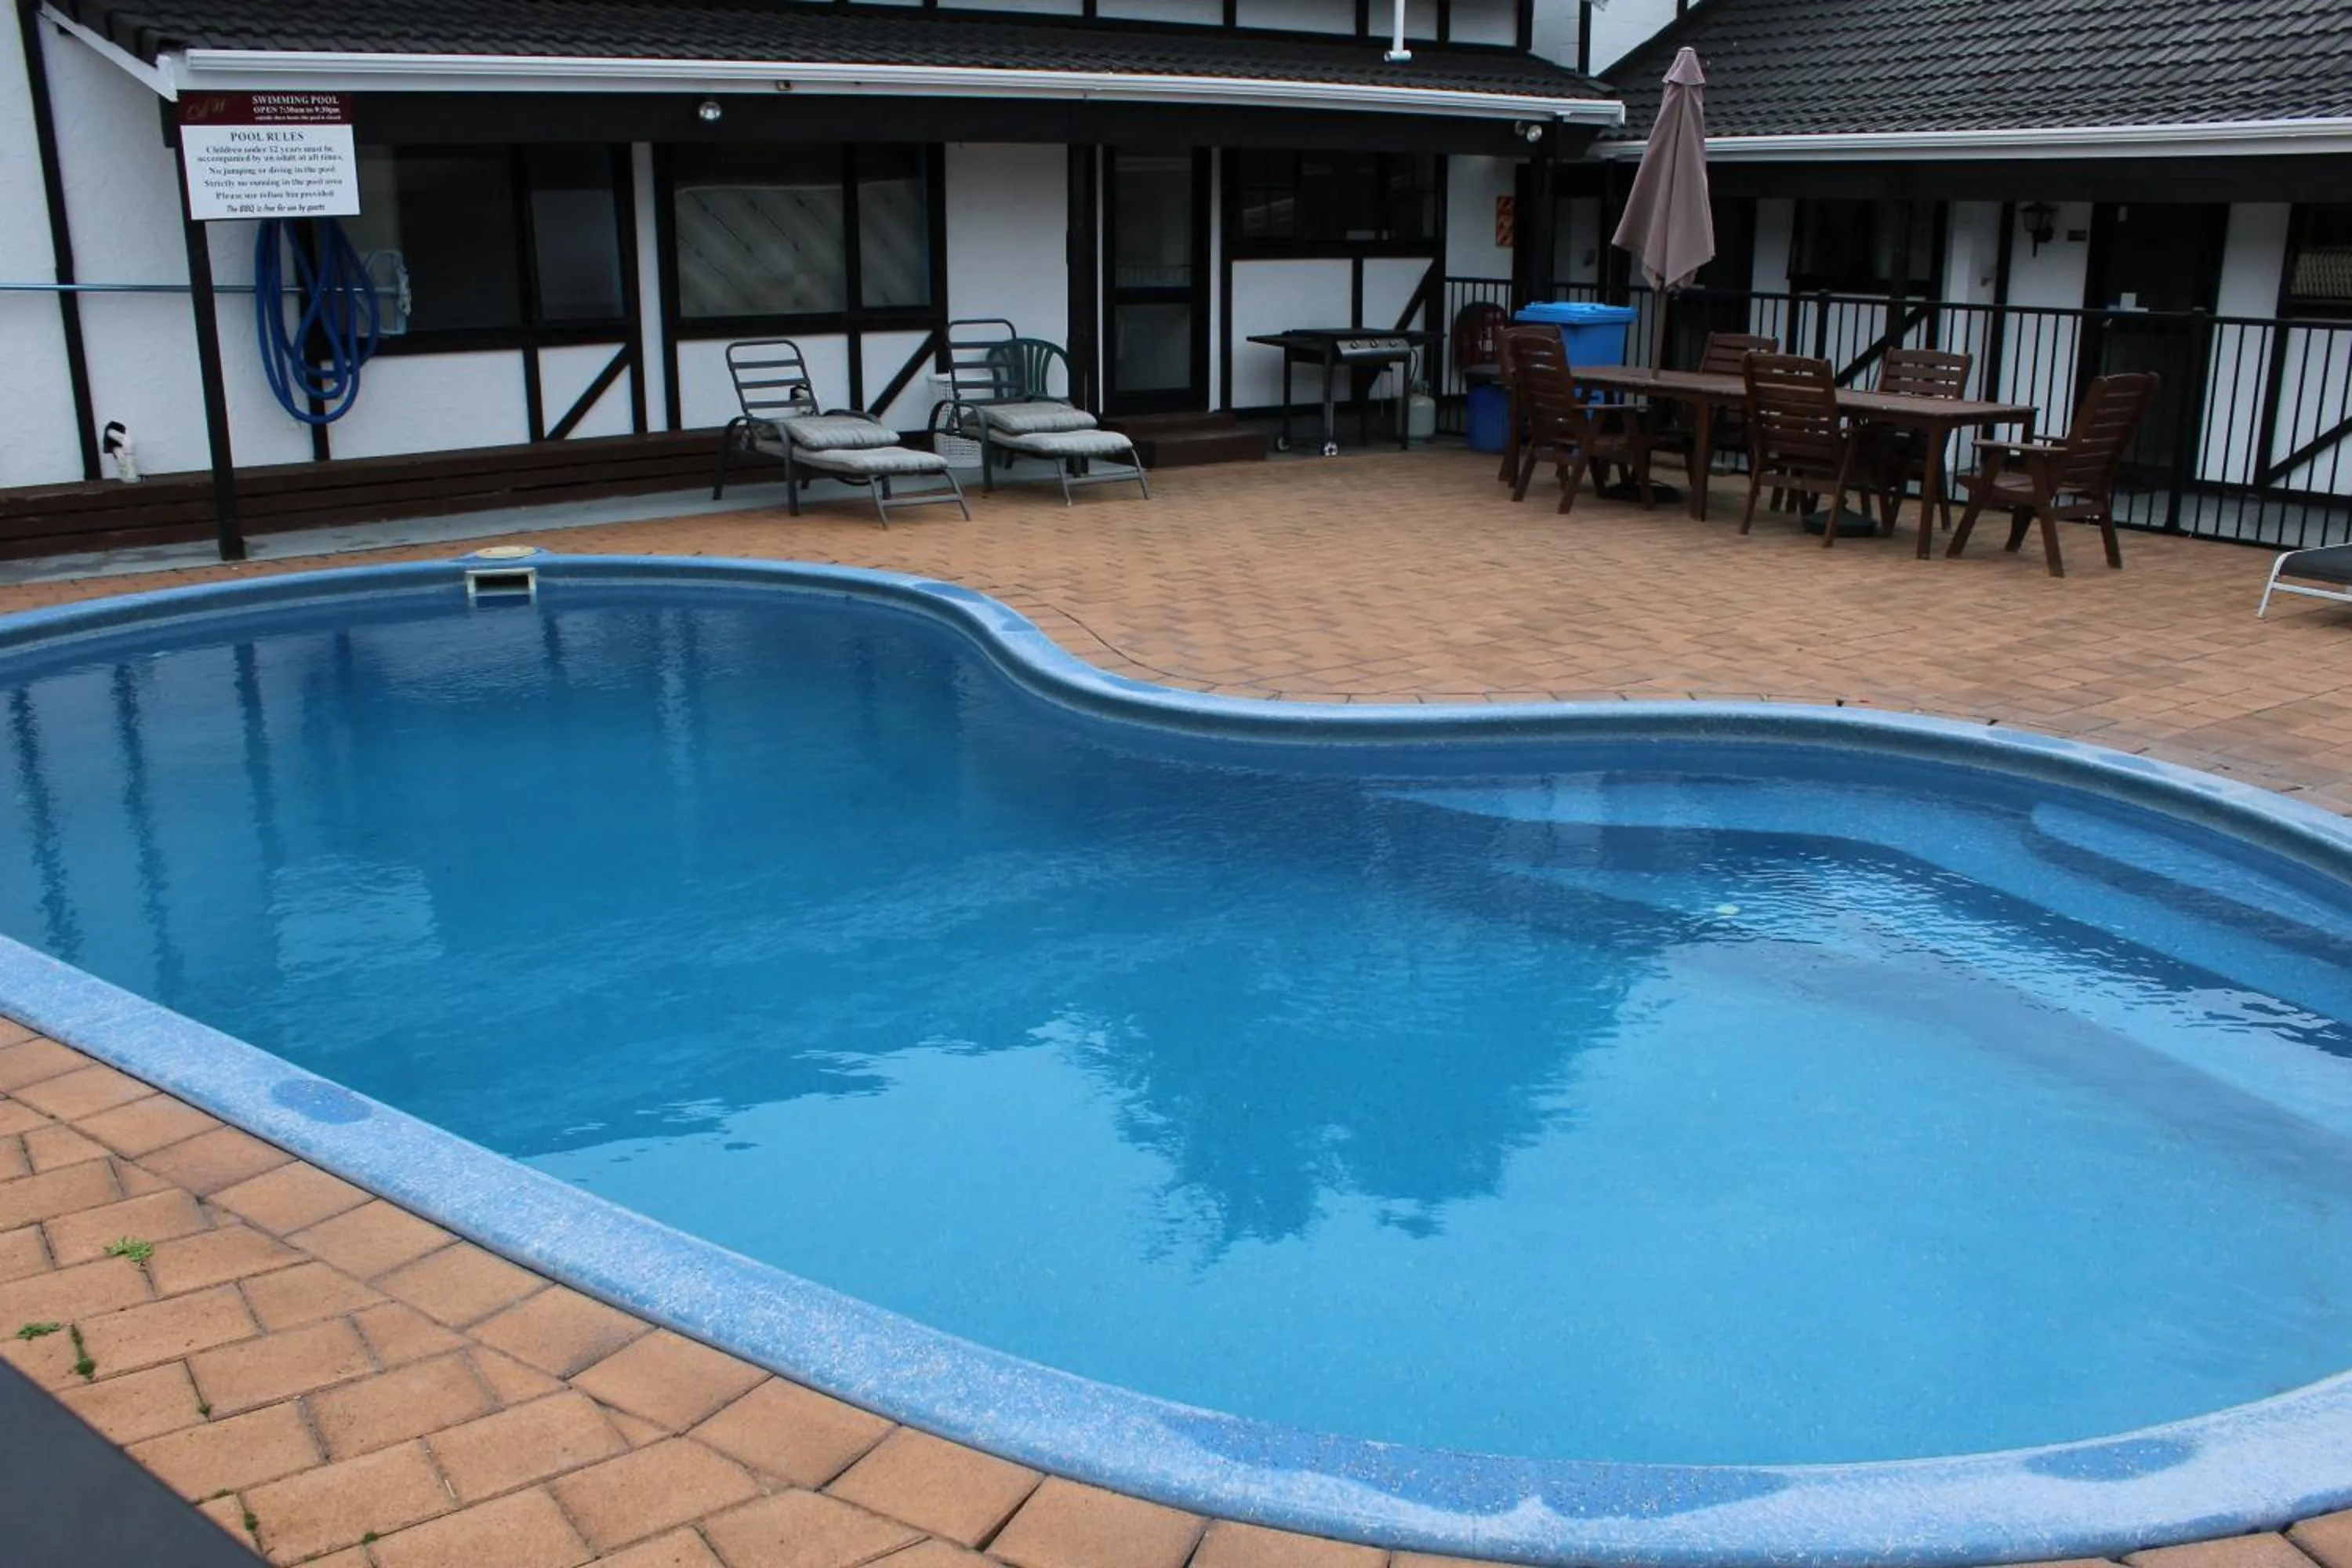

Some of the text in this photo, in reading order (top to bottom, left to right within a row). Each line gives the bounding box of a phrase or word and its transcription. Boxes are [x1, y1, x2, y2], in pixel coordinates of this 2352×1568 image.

[252, 95, 339, 104] SWIMMING POOL
[230, 132, 304, 141] POOL RULES
[197, 154, 251, 163] accompanied
[252, 154, 261, 163] by
[223, 167, 256, 176] jumping
[268, 166, 292, 175] diving
[203, 179, 235, 188] Strictly
[249, 179, 280, 187] running
[306, 178, 323, 187] pool
[216, 191, 242, 200] Please
[300, 190, 335, 199] provided
[239, 204, 255, 213] BBQ
[299, 203, 306, 212] by
